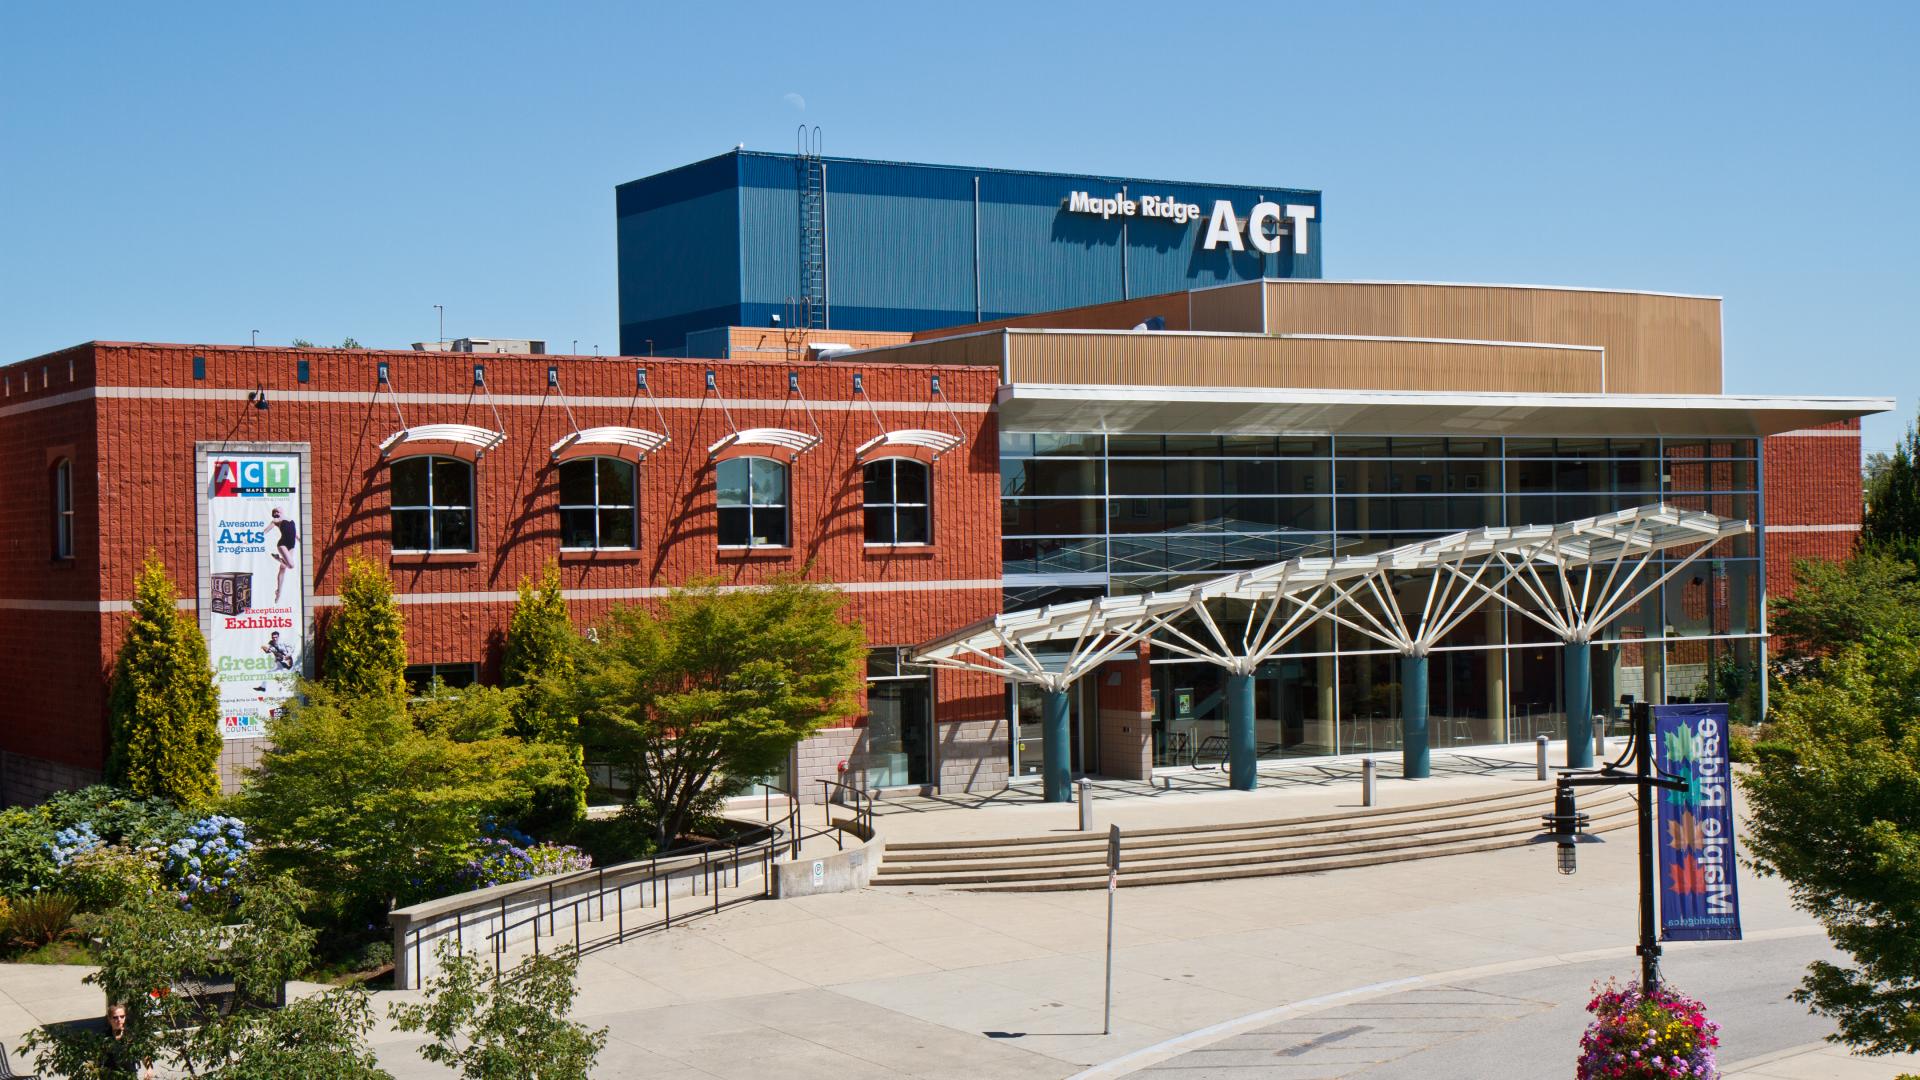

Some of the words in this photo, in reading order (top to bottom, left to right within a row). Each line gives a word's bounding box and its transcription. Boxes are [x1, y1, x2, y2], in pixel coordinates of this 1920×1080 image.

[1069, 191, 1136, 220] Maple
[1141, 195, 1200, 224] Ridge
[1203, 199, 1315, 254] ACT
[215, 462, 287, 483] ACT
[218, 520, 265, 528] Awesome
[217, 529, 265, 544] Arts
[217, 545, 266, 555] Programs
[244, 607, 292, 615] Exceptional
[225, 617, 293, 630] Exhibits
[218, 656, 275, 672] Great
[219, 672, 300, 683] Performance
